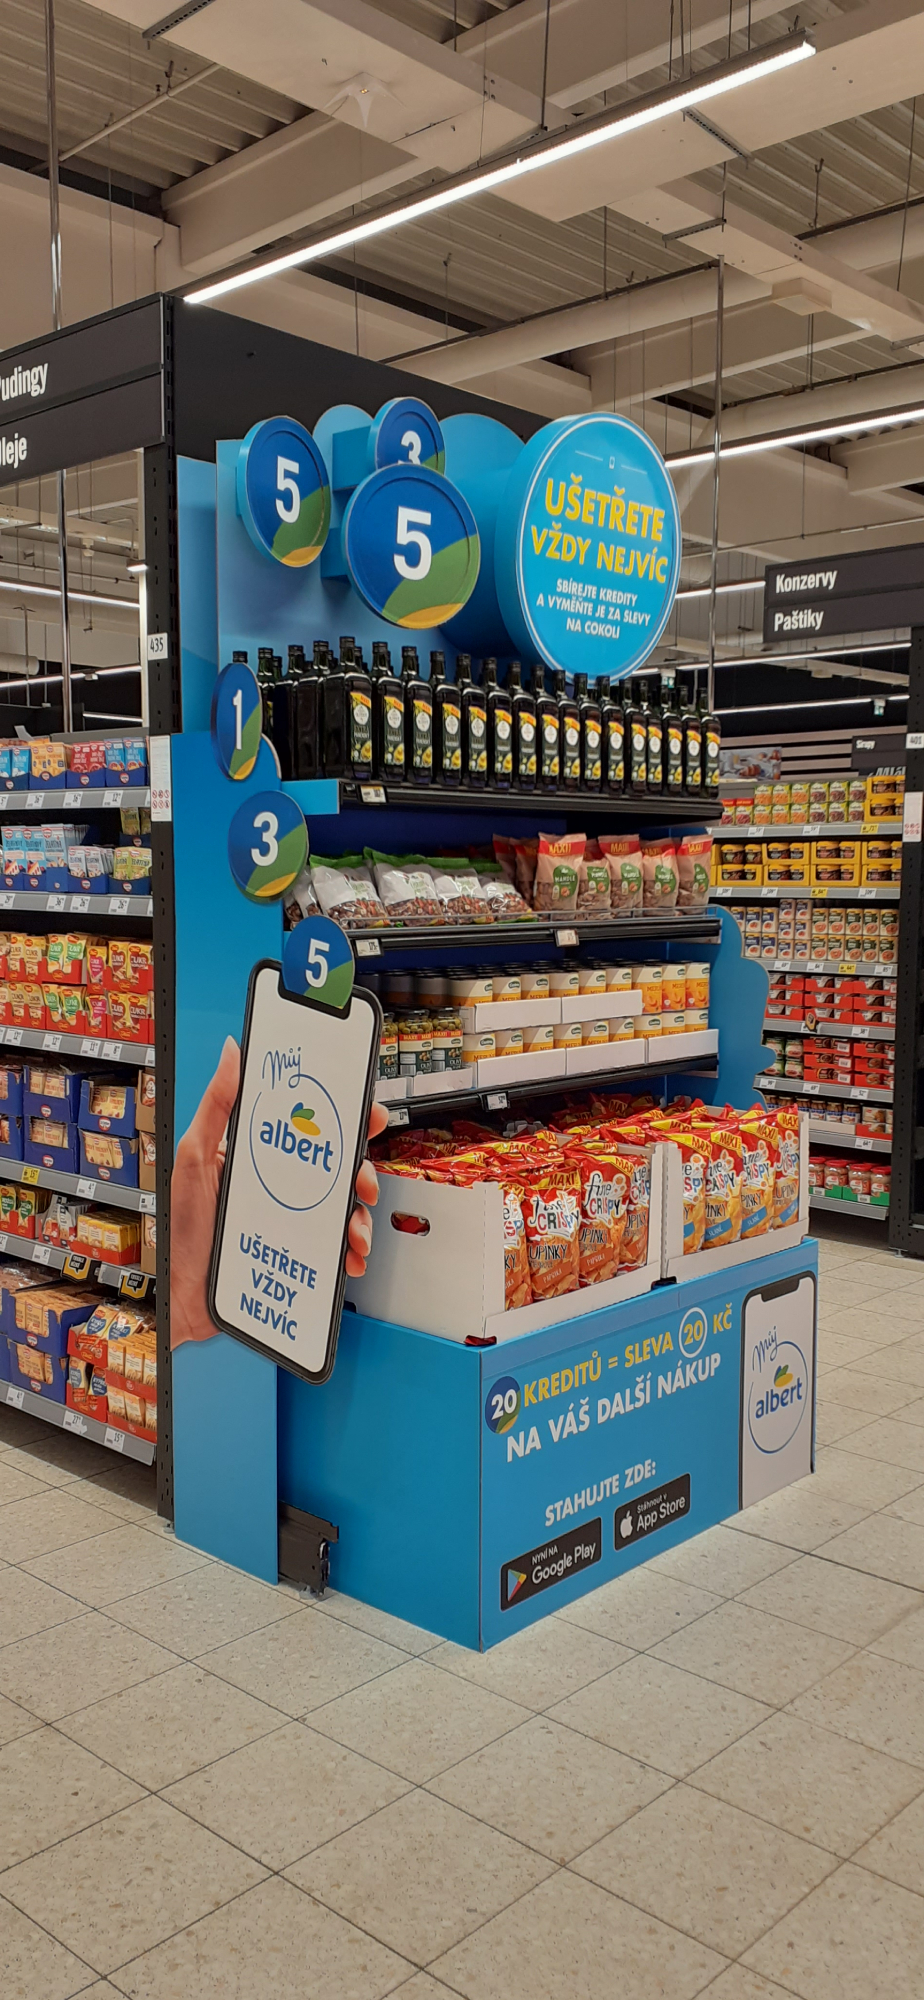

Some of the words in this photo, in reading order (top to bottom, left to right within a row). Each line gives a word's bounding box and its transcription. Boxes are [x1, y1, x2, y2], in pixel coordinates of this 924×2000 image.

[0, 363, 48, 401] udingy
[0, 433, 27, 469] leje
[275, 456, 301, 523] 5
[545, 473, 665, 542] UŠETŘETE
[393, 506, 432, 580] 5
[531, 521, 591, 565] VŽDY
[597, 546, 668, 584] NEJVÍC
[556, 578, 597, 599] SBÍREJTE
[600, 587, 638, 607] KREDITY
[776, 570, 838, 593] Konzervy
[536, 593, 544, 607] A
[548, 594, 593, 616] VYMĚŇTE
[595, 604, 606, 618] JE
[607, 606, 621, 621] ZA
[623, 609, 651, 627] SLEVY
[566, 618, 582, 633] NA
[774, 608, 824, 632] Paštiky
[150, 637, 164, 653] 435
[232, 689, 243, 749] 1
[251, 811, 279, 867] 3
[305, 938, 330, 988] 5
[262, 1047, 302, 1091] Můj
[260, 1118, 334, 1173] albert
[537, 1209, 580, 1232] CRISPY
[590, 1198, 619, 1217] CRISPY
[239, 1231, 318, 1291] UŠETŘETE
[251, 1267, 298, 1309] VŽDY
[239, 1292, 299, 1342] NEJVÍC
[491, 1389, 517, 1420] 20
[524, 1351, 602, 1407] KREDITŮ
[608, 1356, 618, 1369] =
[624, 1331, 674, 1368] SLEVA
[683, 1319, 703, 1346] 20
[712, 1302, 733, 1335] KČ
[752, 1325, 778, 1374] Můj
[507, 1426, 542, 1463] NA
[548, 1396, 591, 1443] VÁŠ
[597, 1372, 652, 1424] DALŠÍ
[657, 1352, 722, 1399] NÁKUP
[755, 1377, 803, 1420] albert
[545, 1474, 620, 1527] STAHUJTE
[624, 1459, 656, 1489] ZDE:
[636, 1509, 658, 1532] App
[659, 1496, 686, 1520] Store
[637, 1493, 663, 1514] Stáhnout
[531, 1548, 547, 1565] NYNÍ
[548, 1544, 559, 1558] NA
[531, 1554, 573, 1585] Google
[574, 1542, 596, 1565] Play
